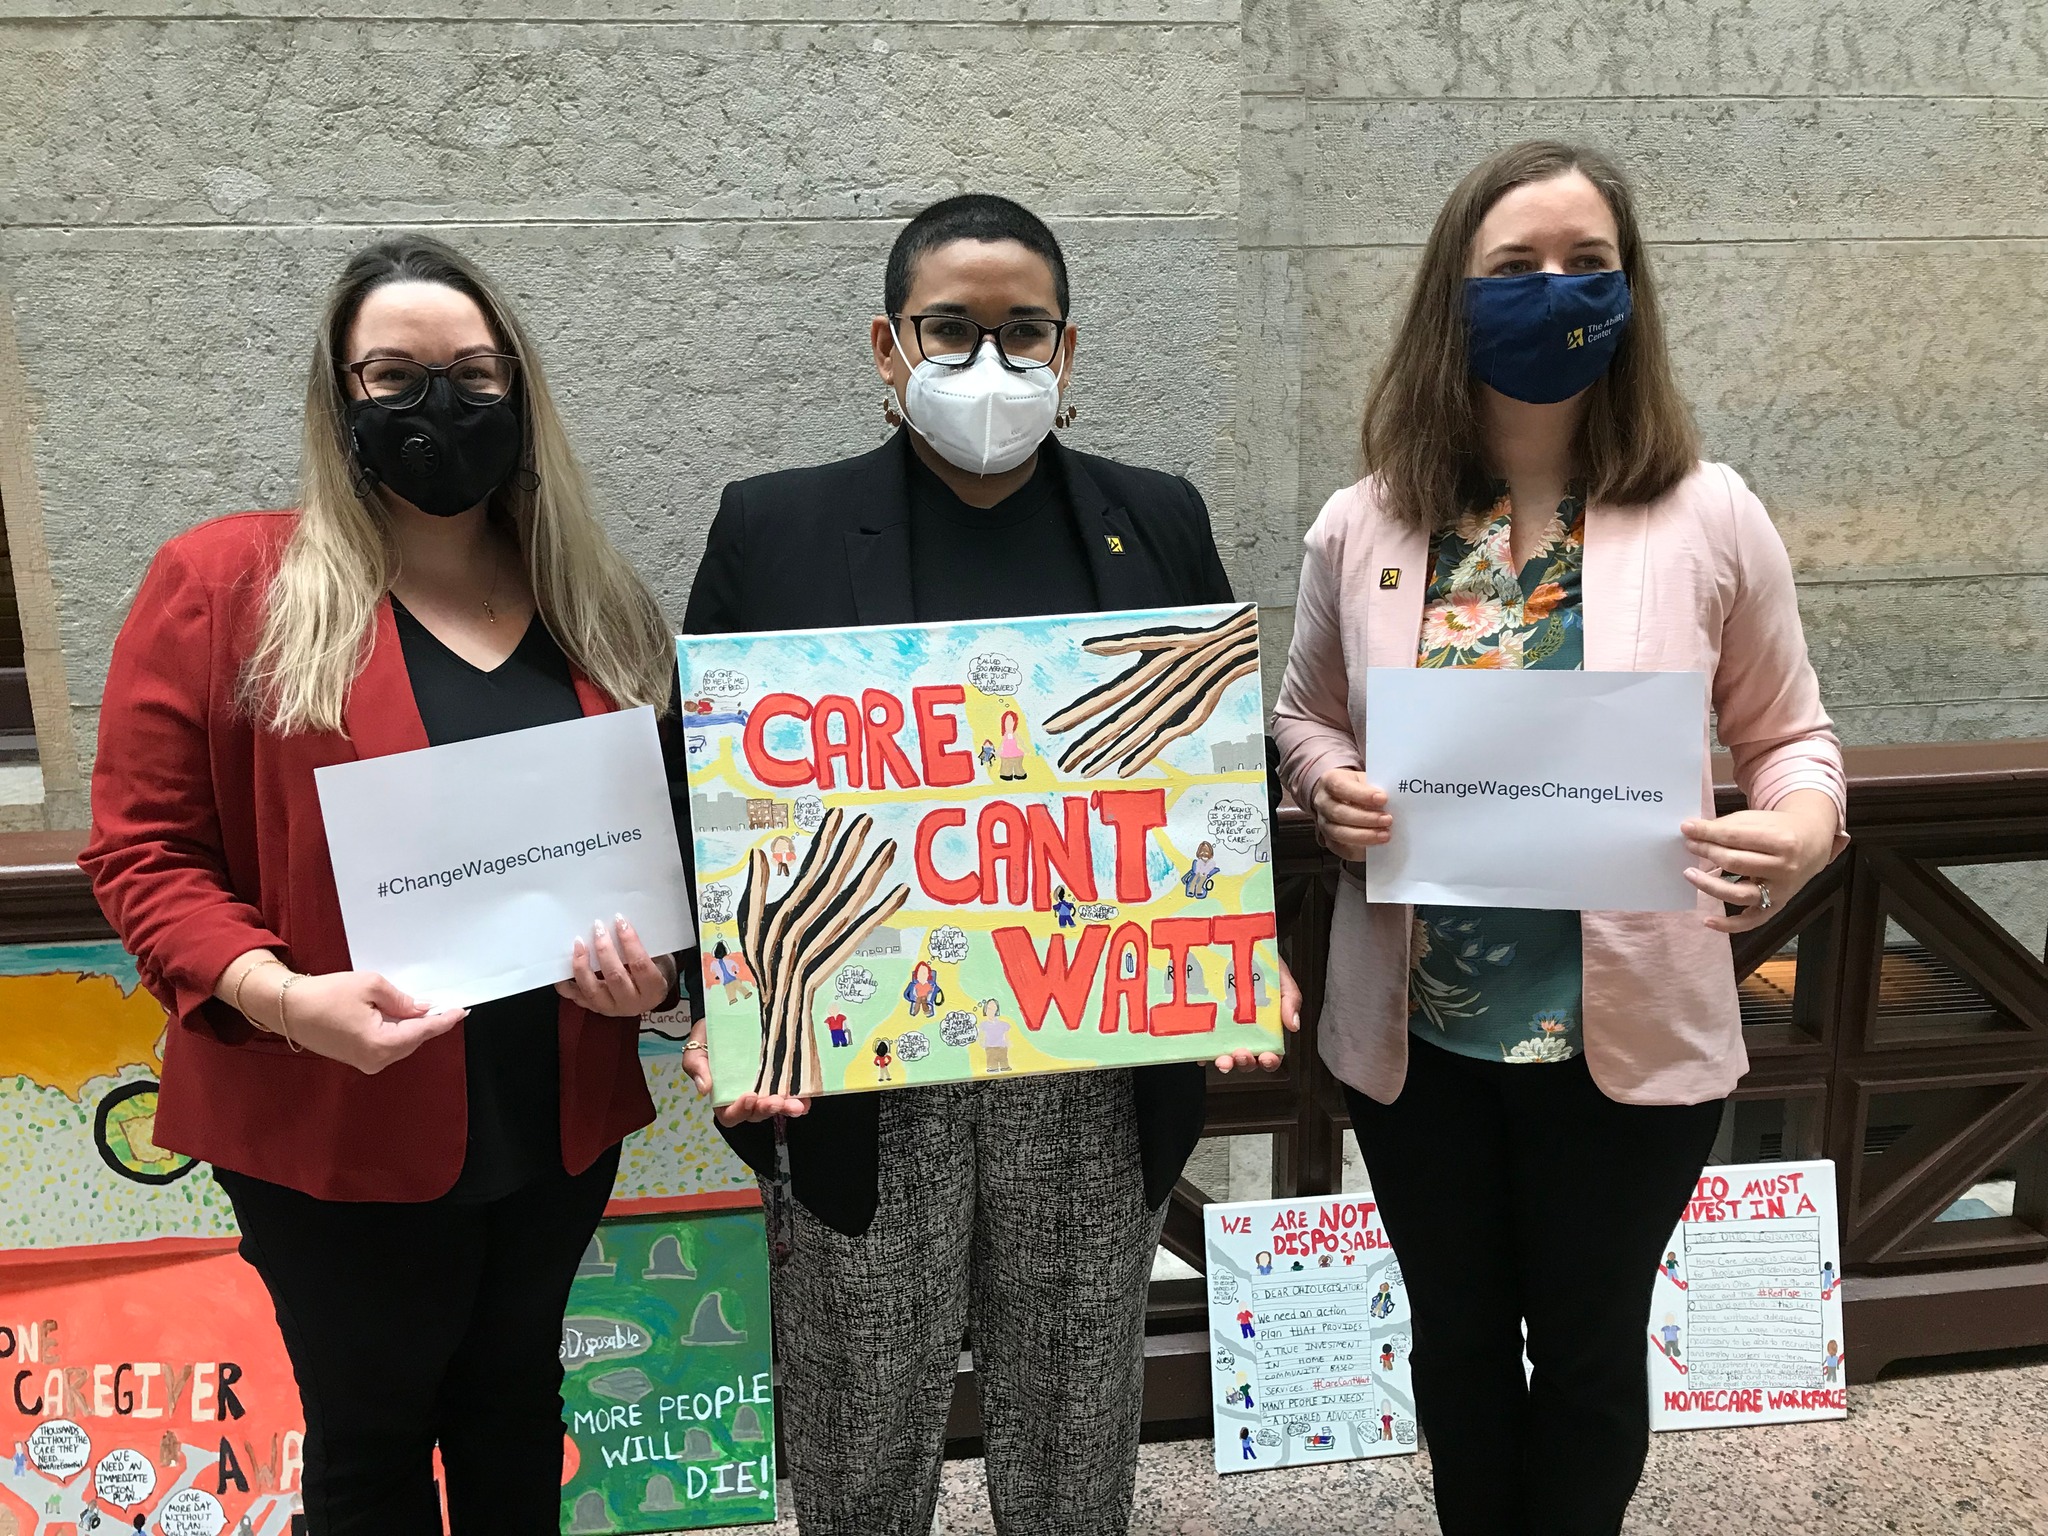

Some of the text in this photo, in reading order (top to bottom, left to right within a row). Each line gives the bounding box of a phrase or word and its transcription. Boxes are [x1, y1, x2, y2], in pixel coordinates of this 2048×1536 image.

[1587, 312, 1625, 333] The Ability
[1587, 328, 1612, 343] Center
[742, 685, 975, 790] CARE
[1398, 779, 1664, 804] #ChangeWagesChangeLives
[805, 801, 820, 809] ONE
[1229, 805, 1252, 813] AGENCY
[1216, 827, 1243, 835] BARELY
[914, 789, 1167, 911] CAN'T
[378, 828, 642, 898] #ChangeWagesChangeLives
[992, 912, 1275, 1036] WAIT
[1741, 1172, 1804, 1198] MUST
[1749, 1196, 1786, 1219] IN
[1796, 1193, 1817, 1215] A
[1220, 1203, 1377, 1235] WE ARE NOT
[1272, 1228, 1393, 1257] DISPOSABL
[1721, 1232, 1748, 1241] OHIO
[1718, 1256, 1737, 1266] Care
[1265, 1287, 1289, 1300] DEAR
[1292, 1284, 1318, 1296] OHIO
[1756, 1288, 1801, 1298] #RedTape
[1257, 1305, 1347, 1325] We need an action
[1322, 1322, 1363, 1334] PROVIDES
[0, 1319, 60, 1364] ONE
[1264, 1340, 1363, 1359] A TRUE INVESTMENT
[1264, 1354, 1353, 1370] IN HOME AND
[1330, 1364, 1355, 1373] BASED
[14, 1362, 246, 1422] CAREGIVER
[574, 1372, 772, 1434] MORE PEOPLE
[1262, 1400, 1285, 1411] MANY
[1288, 1396, 1318, 1408] PEOPLE
[1321, 1395, 1336, 1405] IN
[1664, 1389, 1847, 1412] HOMECARE WORKFORCE
[1282, 1412, 1321, 1425] DISABLED
[39, 1425, 80, 1436] THOUSANDS
[31, 1436, 89, 1446] WITHOUT THE
[33, 1444, 79, 1456] CARE THEY
[112, 1450, 130, 1462] WE
[601, 1431, 683, 1469] WILL
[101, 1460, 142, 1472] NEED AN
[217, 1430, 307, 1495] AWA
[96, 1473, 148, 1484] IMMEDIATE
[687, 1454, 770, 1500] DIE!
[99, 1484, 134, 1495] ACTION
[178, 1493, 200, 1503] ONE
[168, 1501, 212, 1513] MORE DAY
[165, 1513, 212, 1522] WITHOUT
[165, 1522, 171, 1530] A
